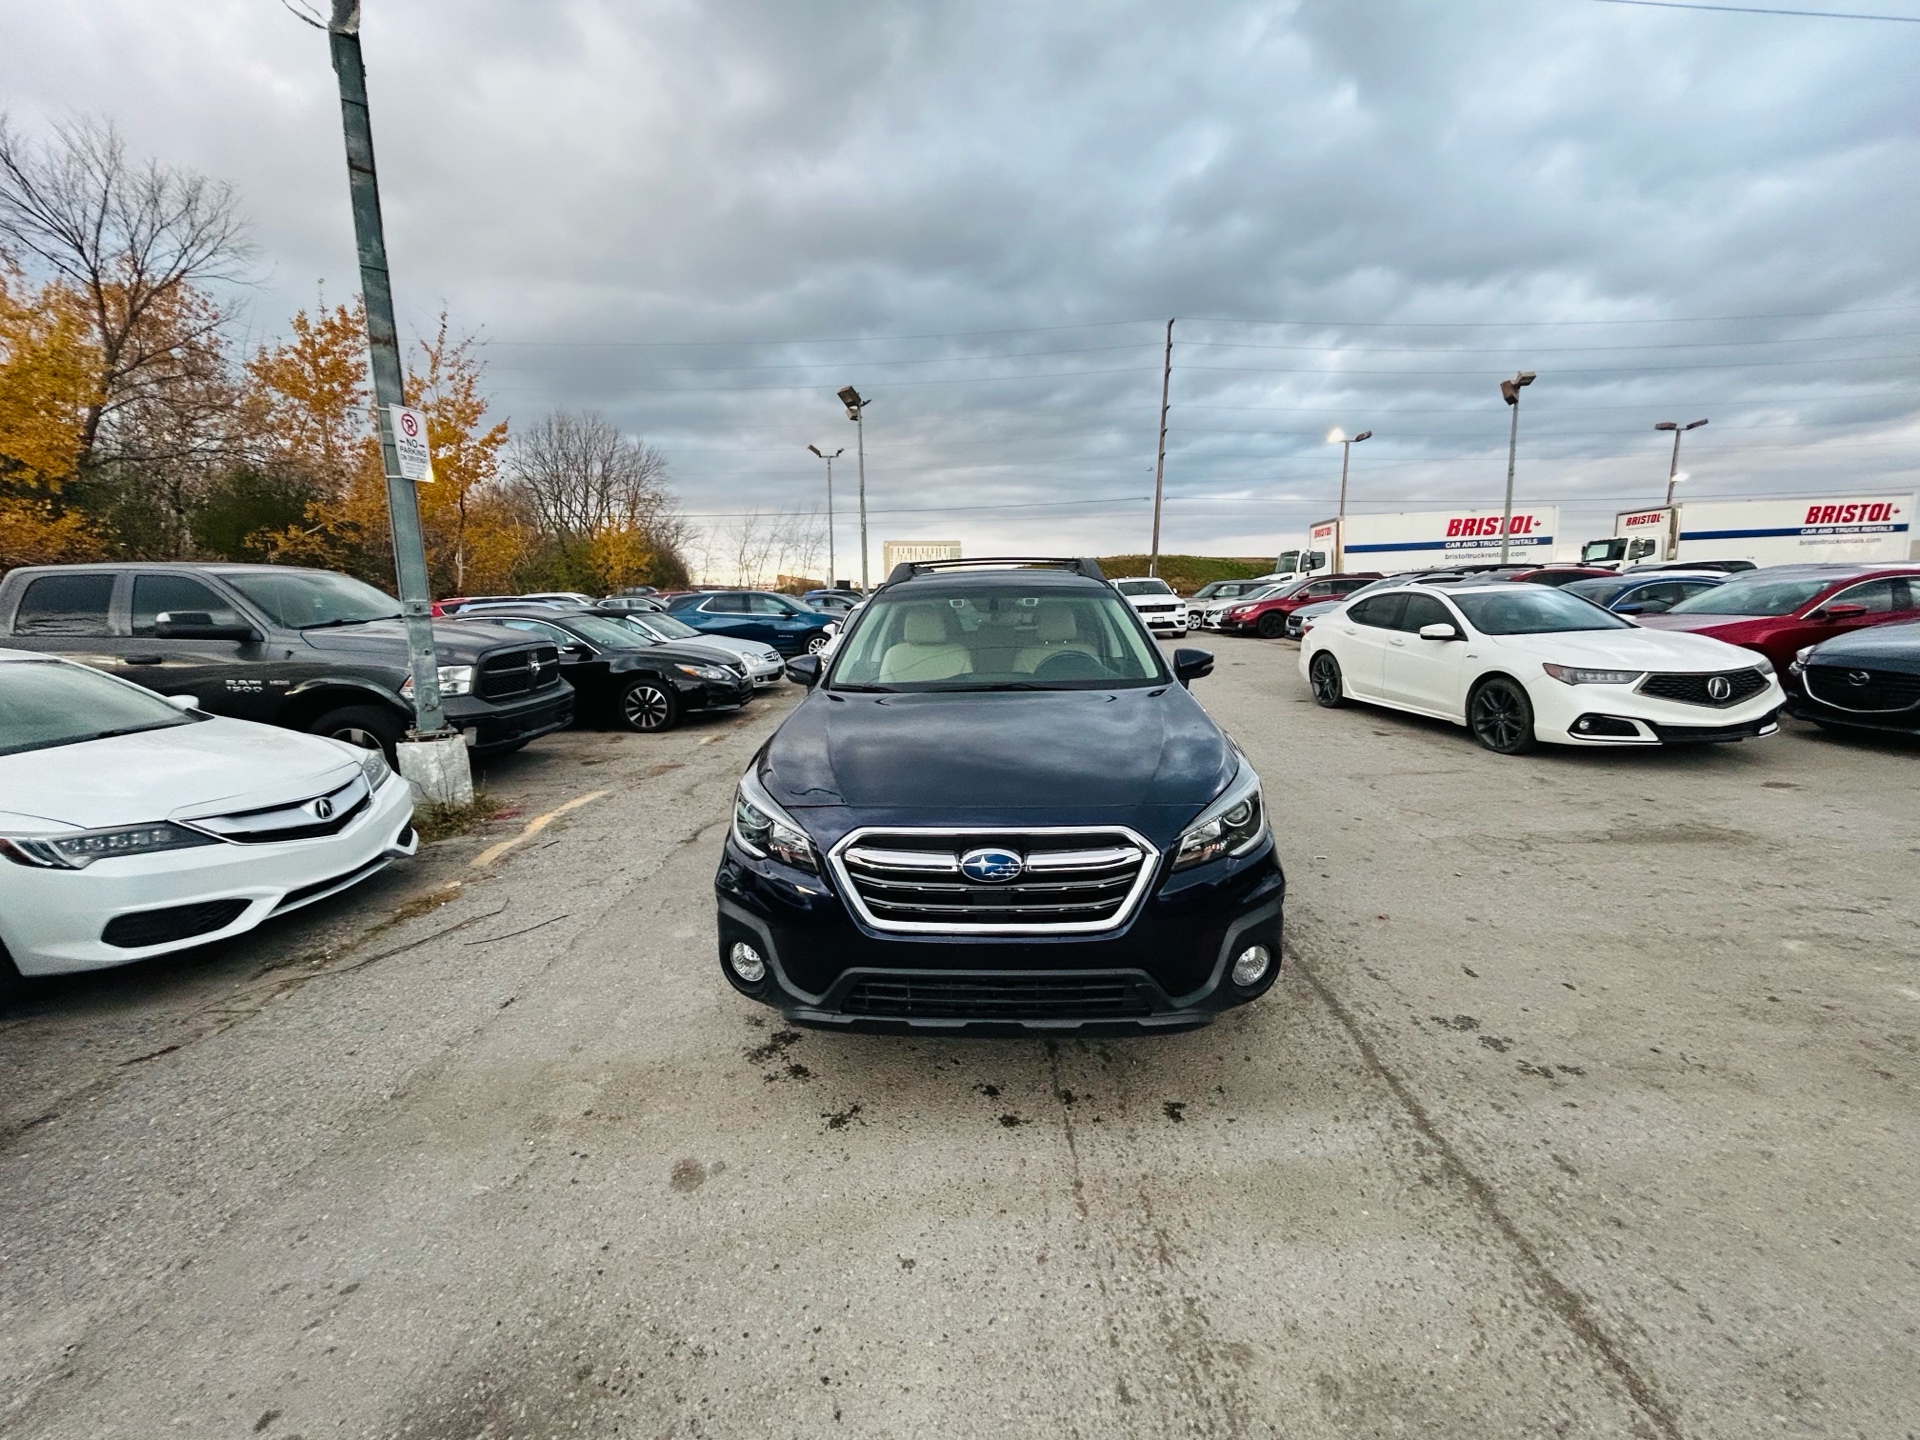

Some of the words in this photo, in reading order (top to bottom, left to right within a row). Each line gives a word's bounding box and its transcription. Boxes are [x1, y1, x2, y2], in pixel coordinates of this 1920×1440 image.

[405, 438, 418, 449] NO
[399, 445, 427, 458] PARKING
[1626, 513, 1661, 526] BRISTOL
[1804, 503, 1893, 524] BRISTOL
[1446, 515, 1533, 537] BRISTOL
[1835, 526, 1860, 534] TRUCK
[1861, 525, 1895, 533] RENTALS
[1480, 539, 1503, 548] TRUCK
